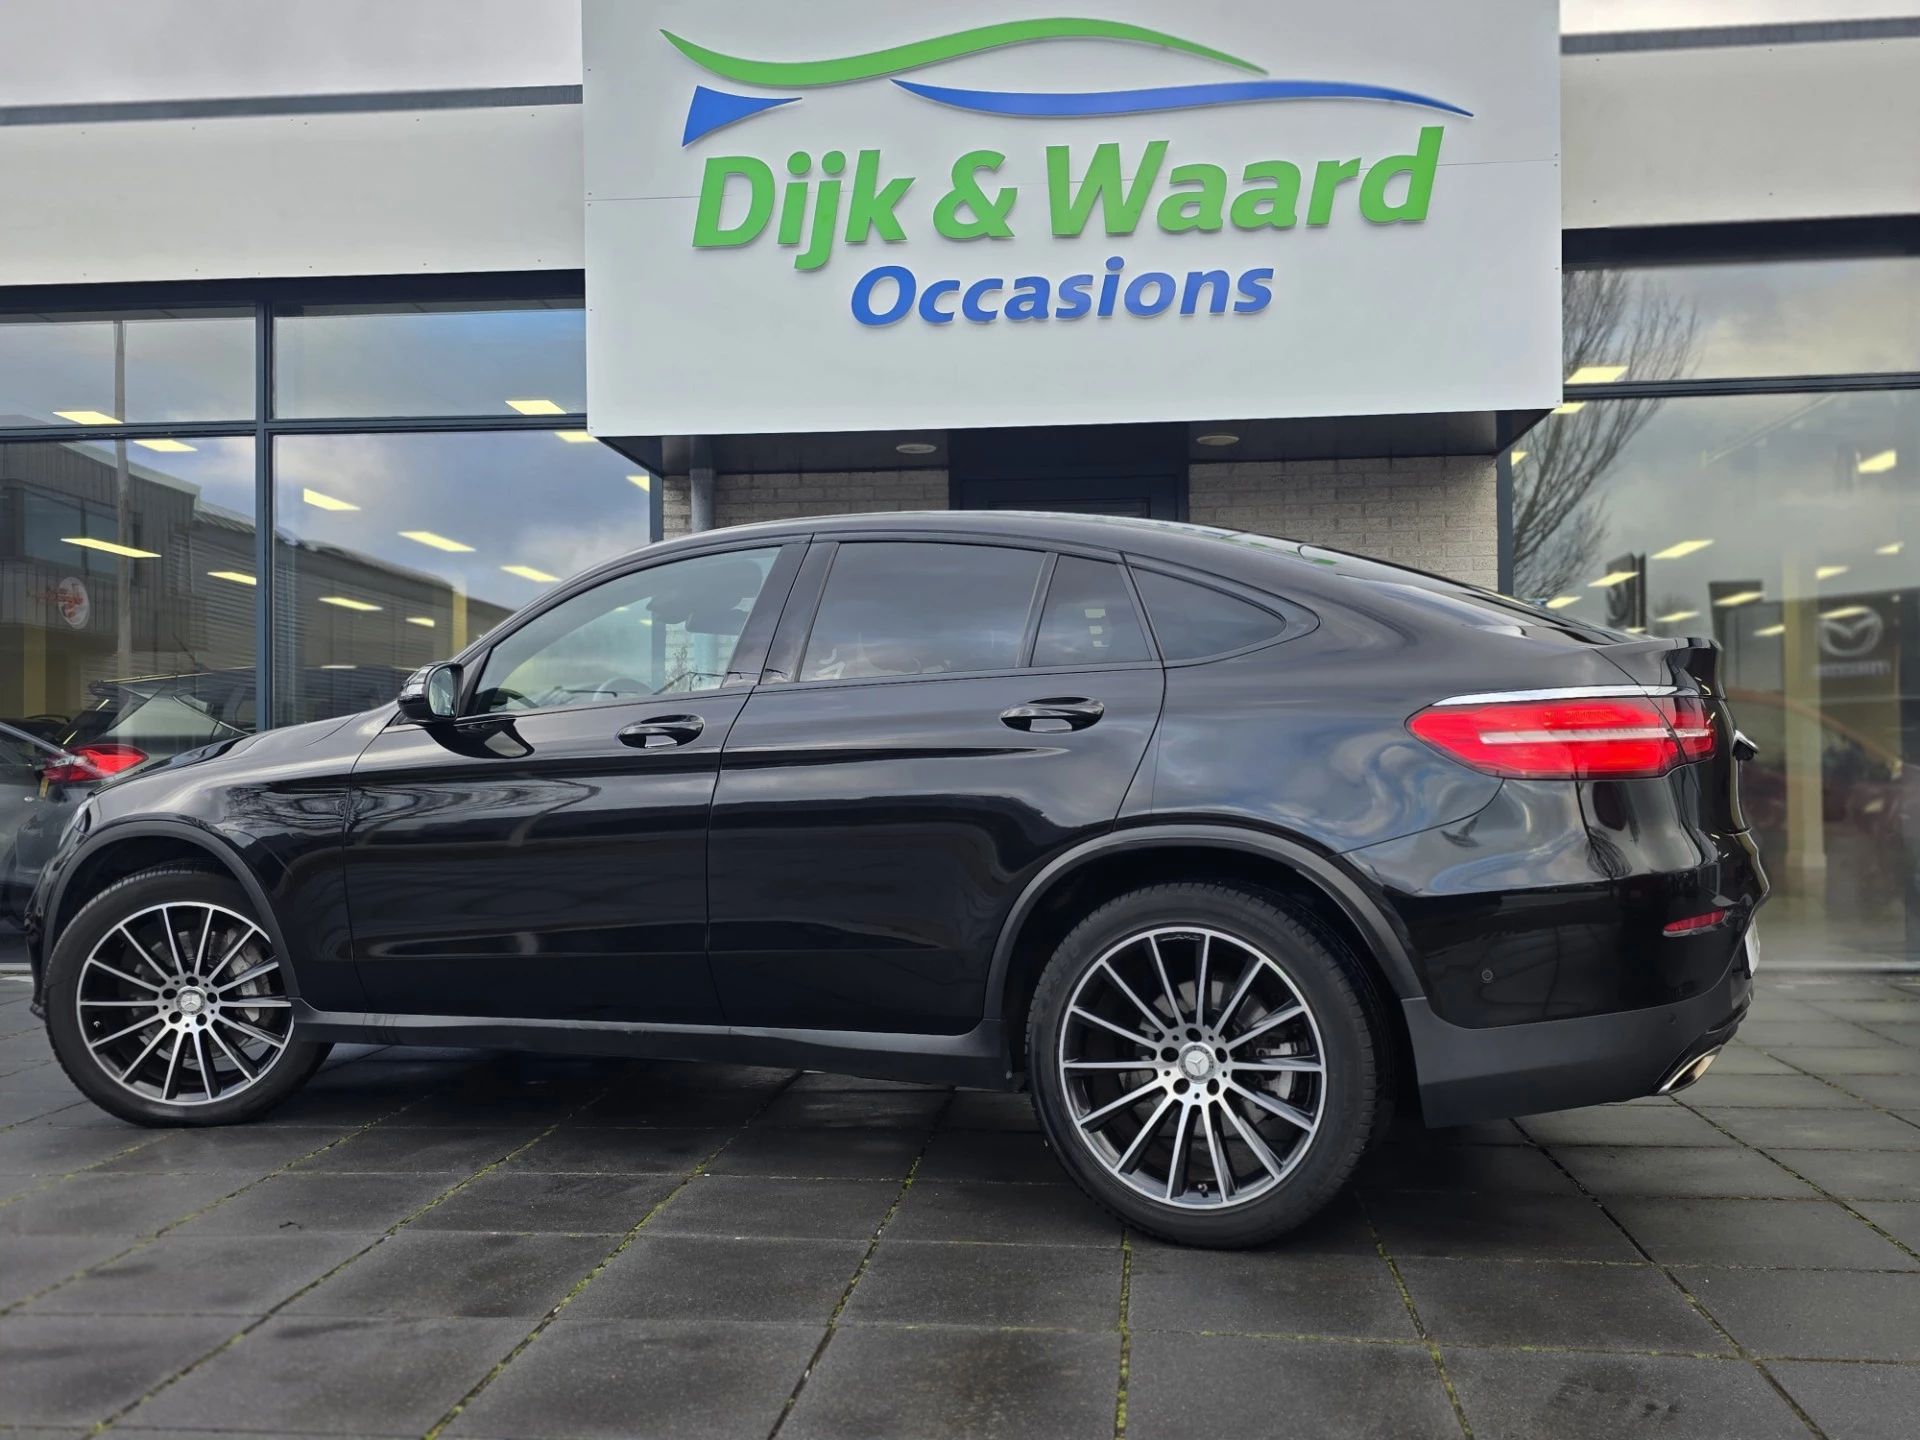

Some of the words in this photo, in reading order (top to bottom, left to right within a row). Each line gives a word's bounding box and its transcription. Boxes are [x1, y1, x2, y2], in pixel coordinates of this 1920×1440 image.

[692, 150, 915, 270] Dijk
[932, 150, 1018, 239] &
[1045, 126, 1445, 237] Waard
[850, 256, 1275, 327] Occasions
